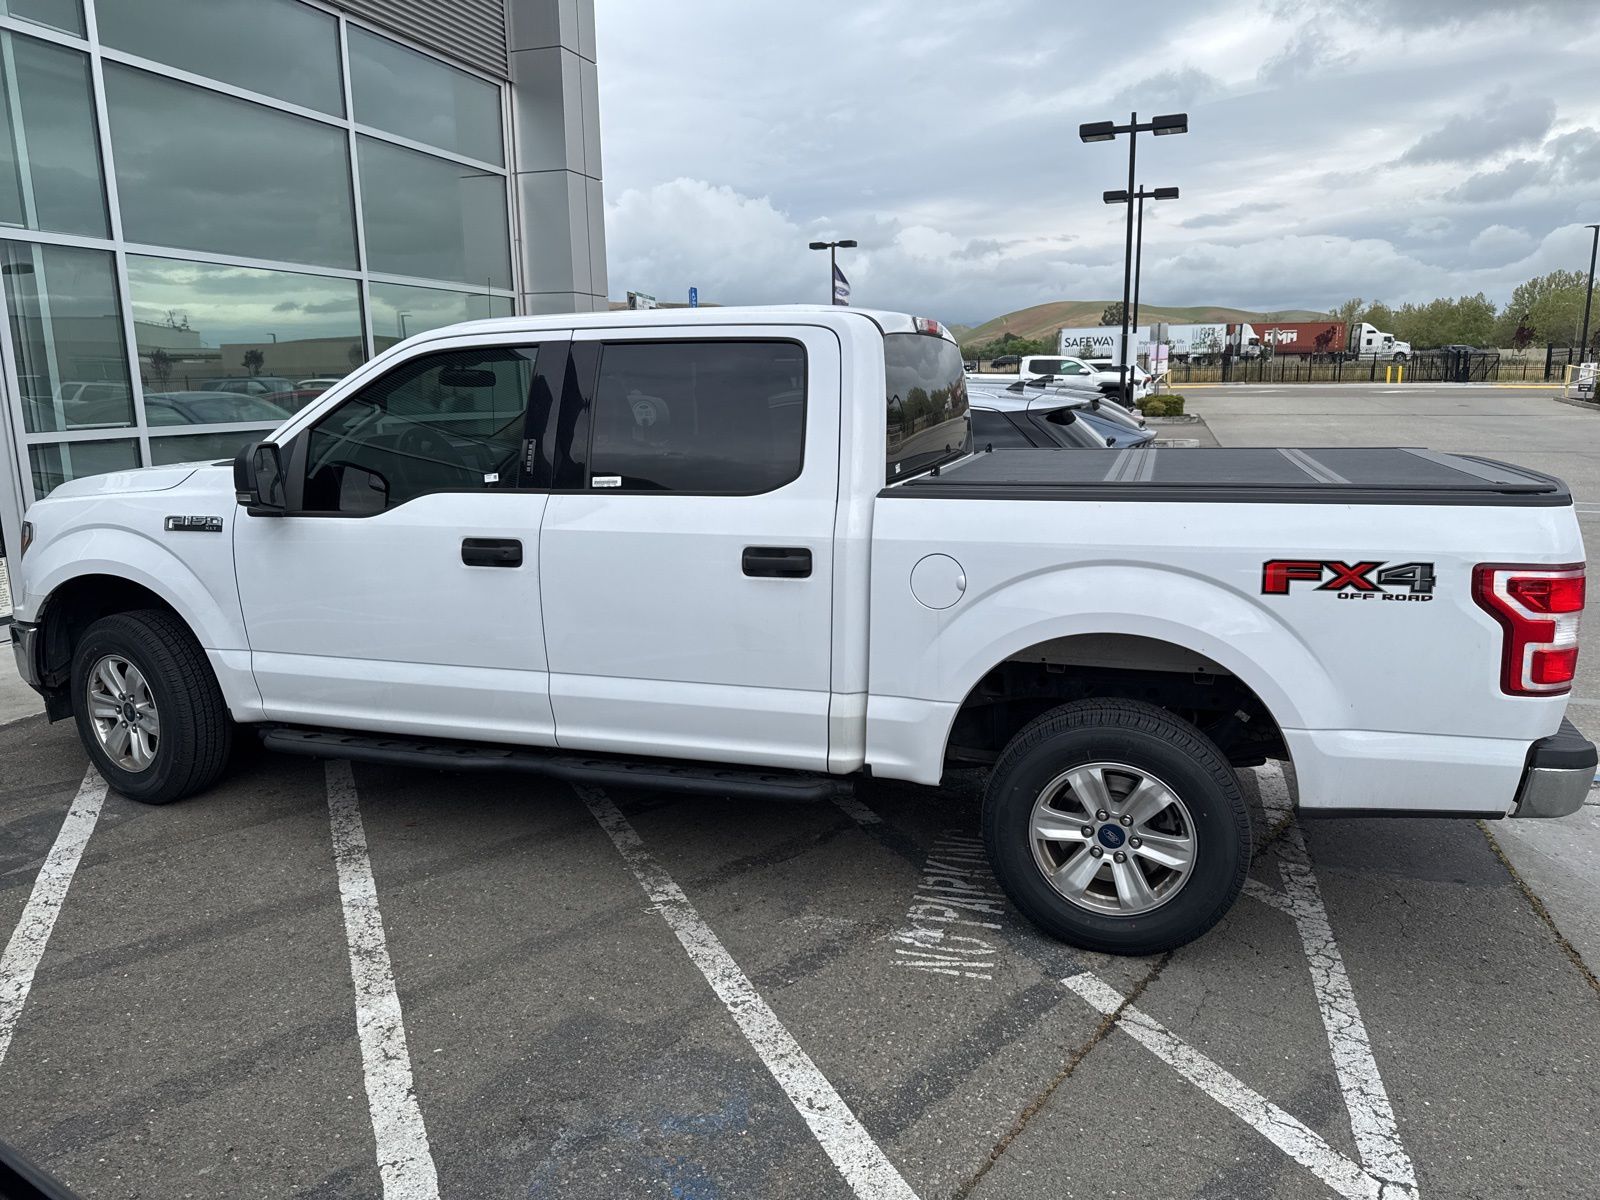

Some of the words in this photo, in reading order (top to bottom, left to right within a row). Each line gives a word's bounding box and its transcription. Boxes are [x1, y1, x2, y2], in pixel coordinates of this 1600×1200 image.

[1064, 336, 1114, 347] SAFEWAY
[1261, 559, 1437, 596] FX4
[1337, 592, 1375, 600] OFF
[1382, 593, 1434, 602] ROAD
[891, 928, 997, 980] NO
